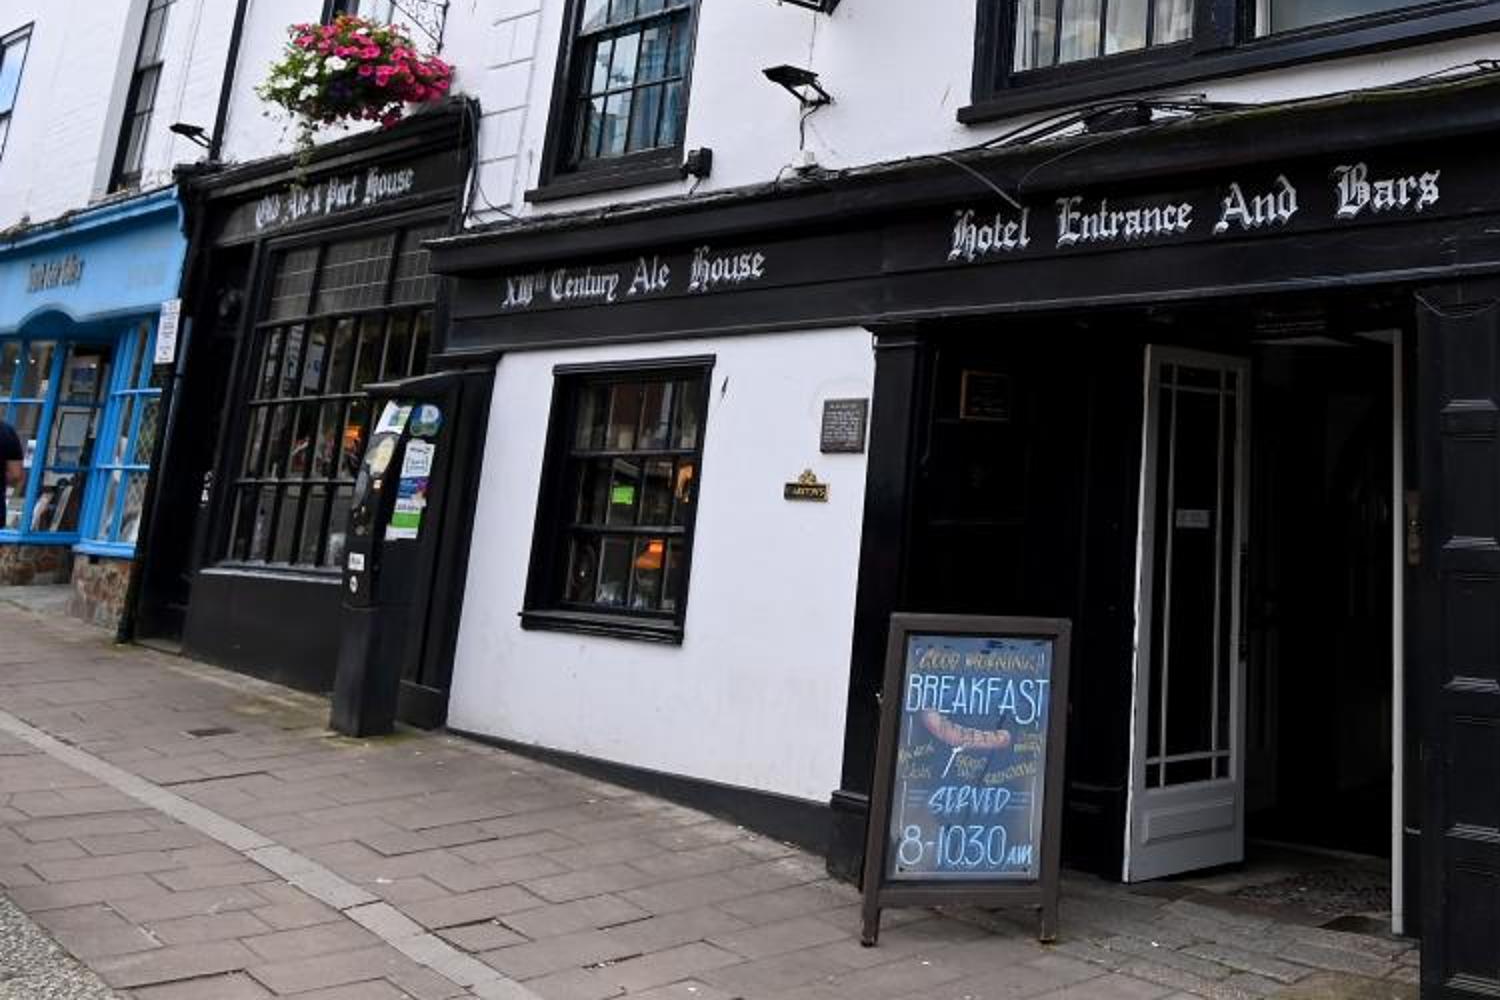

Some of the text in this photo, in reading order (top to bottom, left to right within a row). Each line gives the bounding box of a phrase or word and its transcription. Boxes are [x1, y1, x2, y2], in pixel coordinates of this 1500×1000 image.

[363, 167, 415, 204] House
[948, 161, 1440, 261] Hotel Entrance And Bars
[551, 266, 619, 302] Century
[628, 254, 670, 295] Ale
[688, 245, 765, 293] House
[906, 674, 1049, 724] BREAKFAST
[928, 785, 1011, 814] SERVED
